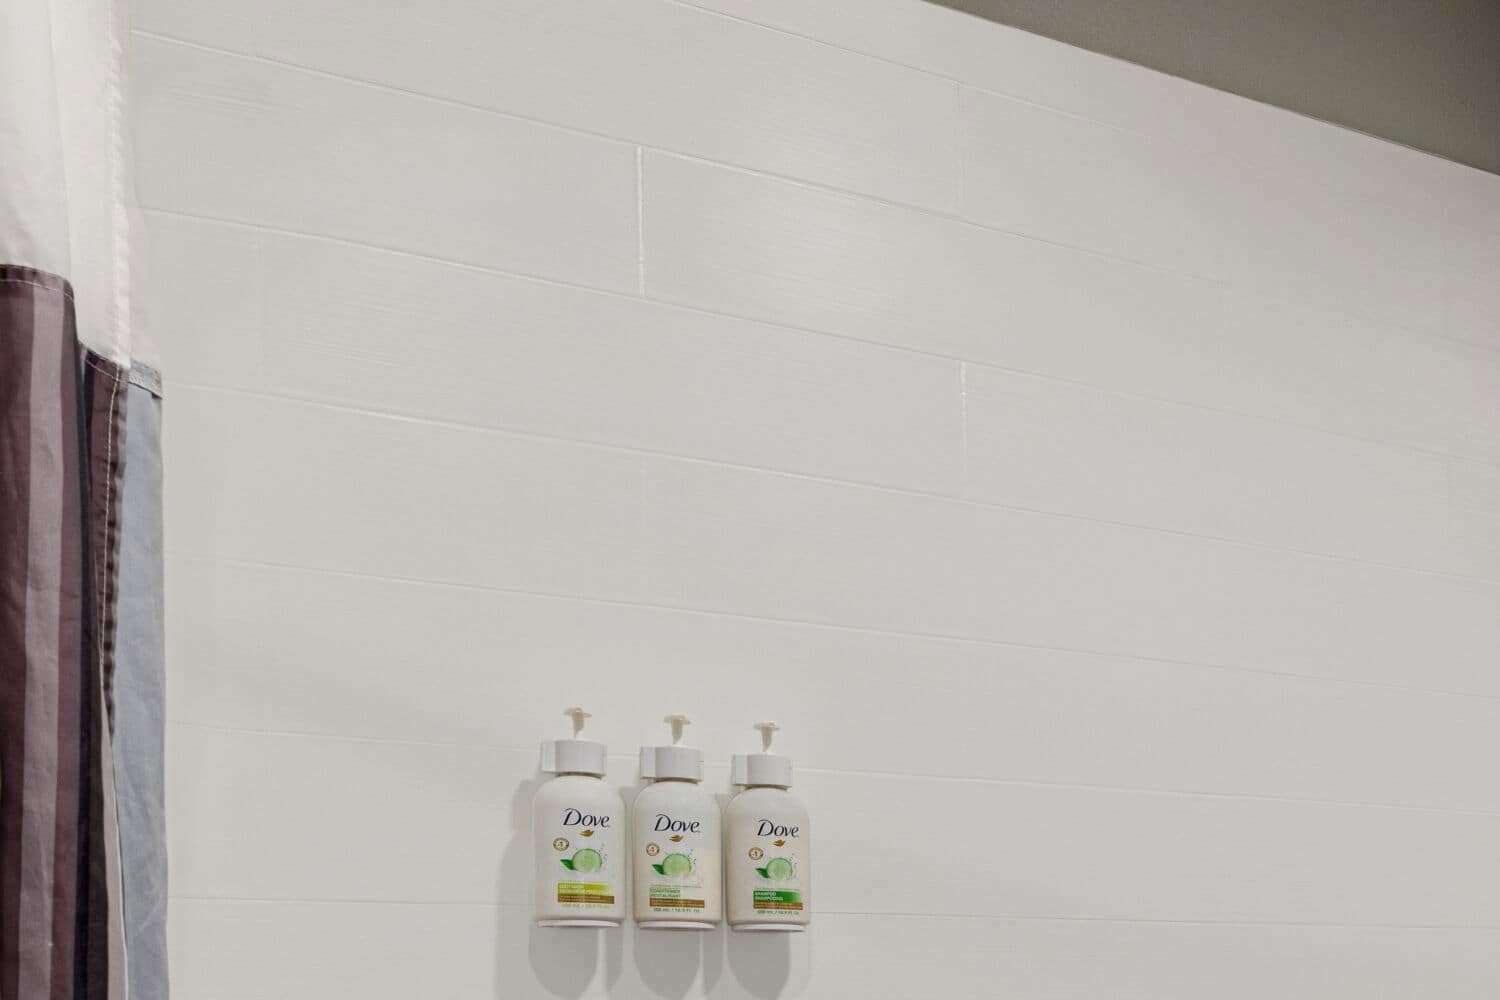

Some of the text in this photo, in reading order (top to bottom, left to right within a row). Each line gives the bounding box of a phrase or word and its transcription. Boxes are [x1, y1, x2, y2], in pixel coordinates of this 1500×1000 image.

[562, 807, 610, 828] Dove
[655, 813, 700, 833] Dove
[757, 819, 800, 837] Dove
